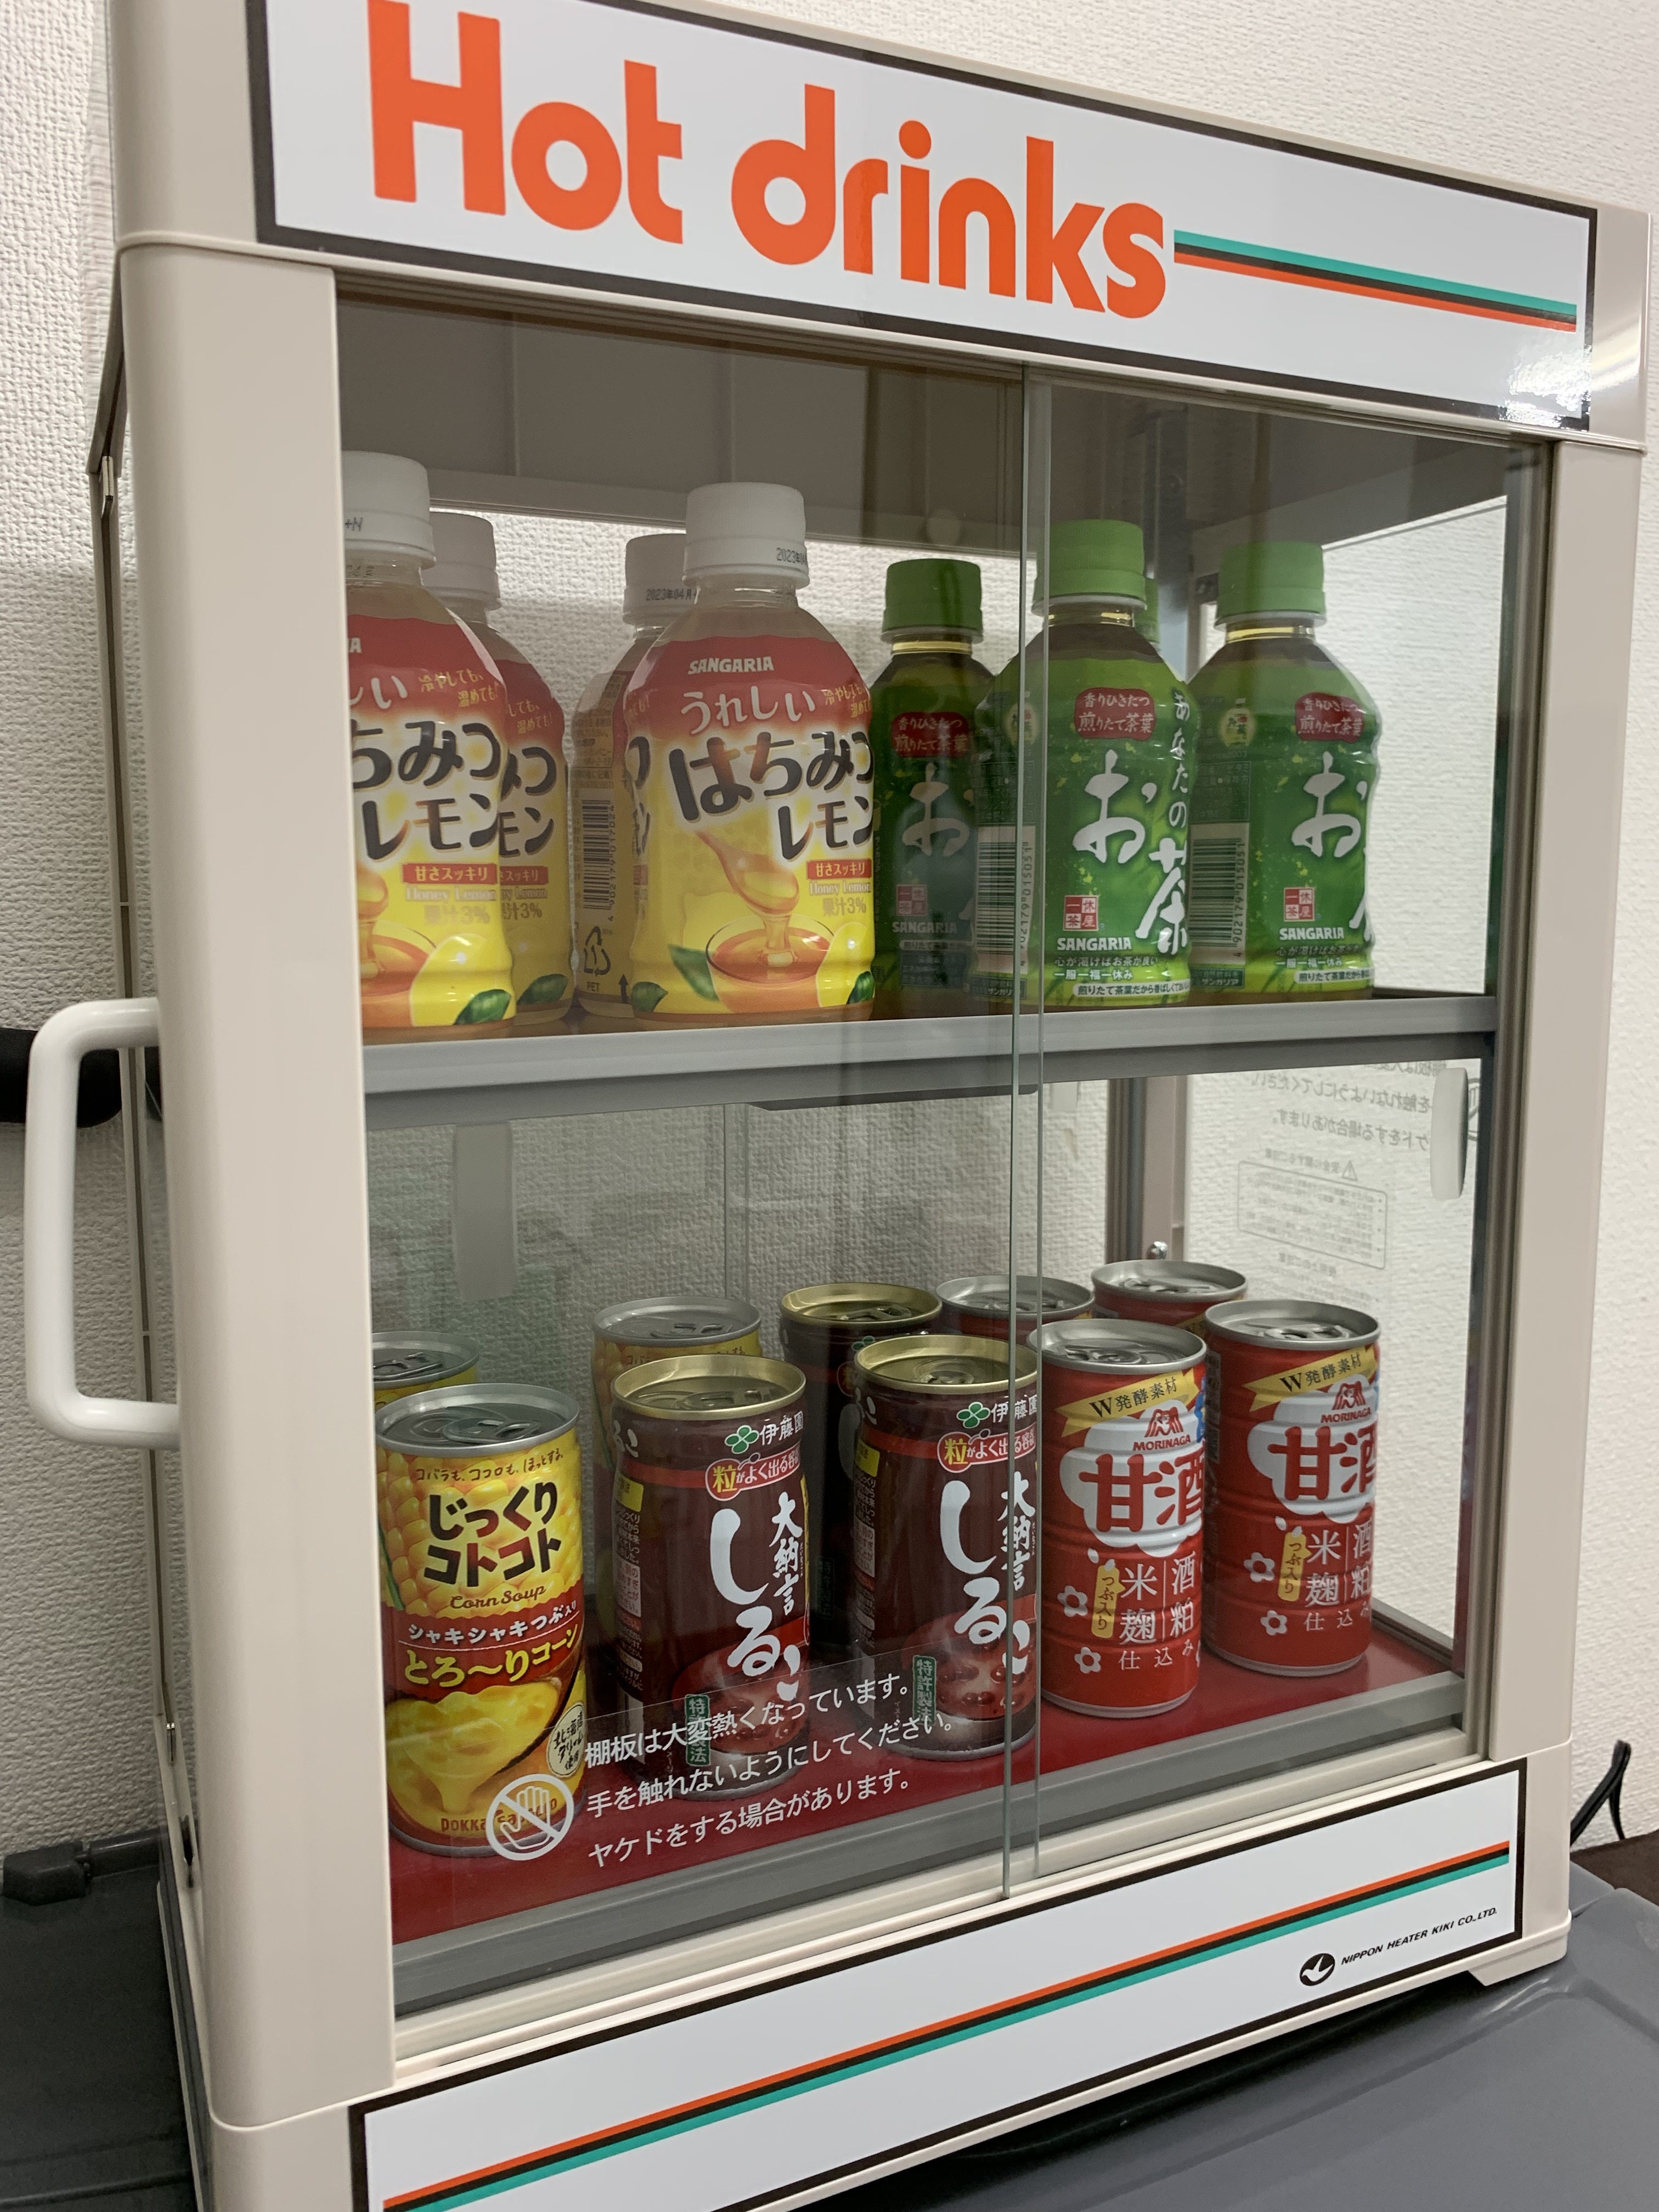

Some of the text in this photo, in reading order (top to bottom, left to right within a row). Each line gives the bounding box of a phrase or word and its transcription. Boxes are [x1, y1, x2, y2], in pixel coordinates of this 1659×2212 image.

[367, 0, 1164, 319] Hot drinks
[688, 656, 775, 675] SANGARIA
[681, 685, 816, 735] うれしい
[1084, 692, 1150, 708] 香りひきたつ
[898, 715, 963, 731] 香りひきたつ
[1077, 713, 1154, 733] 煎りたて茶葉
[1299, 714, 1363, 736] 煎りたて茶葉
[1169, 690, 1190, 829] あなたの
[902, 762, 973, 857] お
[1072, 749, 1157, 864] お
[1291, 751, 1369, 857] お
[362, 793, 498, 860] レモン
[415, 865, 489, 882] 甘さスッキリ
[809, 880, 872, 895] Honey Lemon
[816, 862, 866, 878] 甘さスッキリ
[406, 885, 496, 904] Honey Lemon
[823, 898, 867, 915] 果汁3%
[1065, 896, 1097, 913] 一休
[892, 921, 957, 933] SANGARIA
[1065, 913, 1097, 929] 茶屋
[1279, 927, 1345, 940] SANGARIA
[1057, 936, 1132, 951] SANGARIA
[1053, 969, 1133, 980] 一服一福一休み
[1279, 1352, 1362, 1393] W発酵素材
[990, 1393, 1037, 1424] 伊藤園
[1089, 1376, 1178, 1418] W発酵素材
[1320, 1407, 1372, 1424] MORINAGA
[759, 1410, 804, 1446] 伊藤園
[1132, 1434, 1191, 1452] MORINAGA
[1267, 1421, 1376, 1501] 甘酒
[1079, 1445, 1206, 1532] 甘酒
[429, 1481, 558, 1541] じっくり
[997, 1471, 1036, 1591] 大納言
[424, 1527, 562, 1588] コトコト
[769, 1491, 803, 1616] 大納言
[1283, 1542, 1302, 1594] つぶ入り
[1304, 1530, 1341, 1608] 米麹
[450, 1583, 547, 1611] Corn Soup
[710, 1508, 801, 1701] しるこ
[1096, 1576, 1115, 1630] つぶ入り
[1120, 1563, 1158, 1645] 米麹
[1170, 1550, 1197, 1638] 酒粕
[408, 1600, 577, 1645] シャキシャキつぶ入り
[1118, 1638, 1194, 1671] 仕込み
[585, 1673, 908, 1768] 棚板は大変熱くなっています。
[587, 1713, 952, 1819] 手を触れないようにしてください。
[588, 1768, 909, 1867] ヤケドをする場合があります。
[1341, 1944, 1383, 1966] NIPPON
[1386, 1929, 1429, 1950] HEATER
[1431, 1920, 1454, 1935] KIKI
